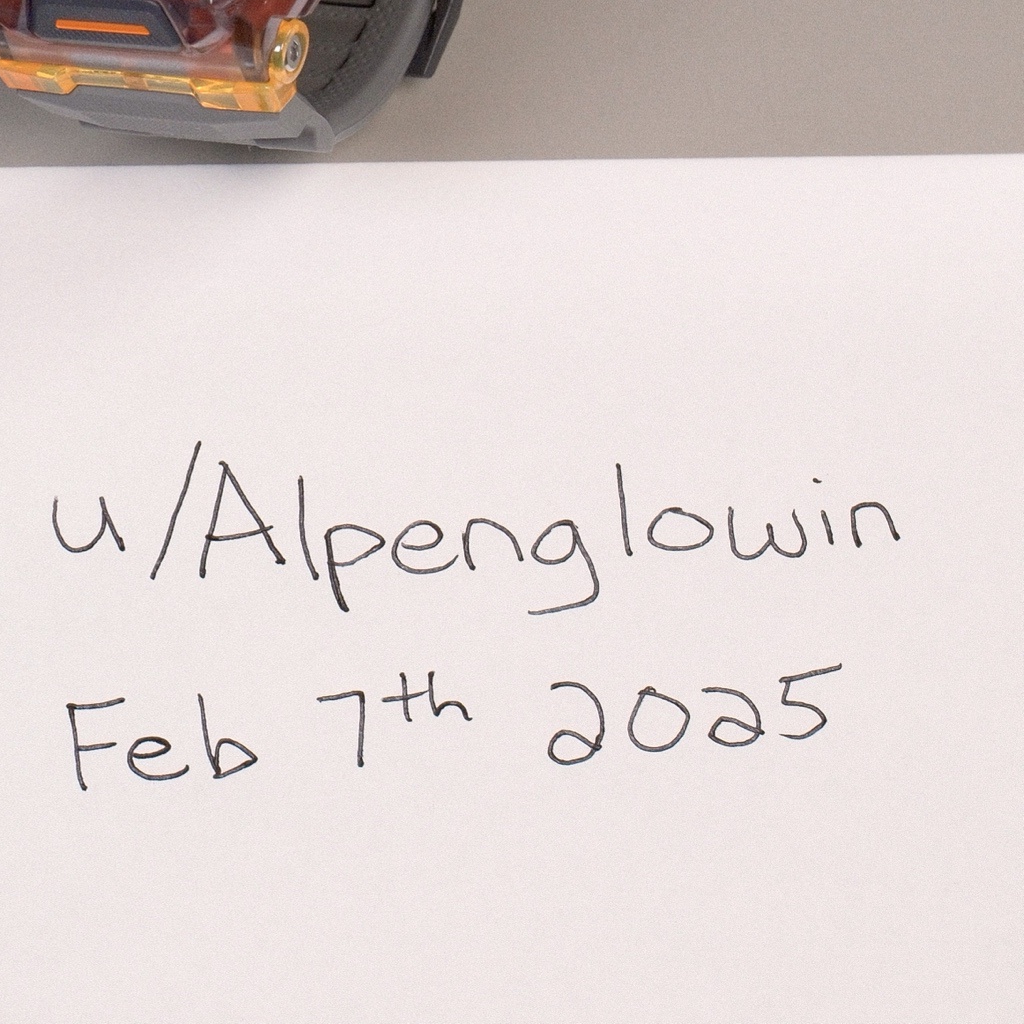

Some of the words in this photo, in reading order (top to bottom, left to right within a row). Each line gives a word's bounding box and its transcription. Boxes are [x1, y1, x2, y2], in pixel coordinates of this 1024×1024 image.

[66, 693, 259, 791] Feb
[317, 671, 473, 767] 7th
[547, 663, 843, 766] 2025
